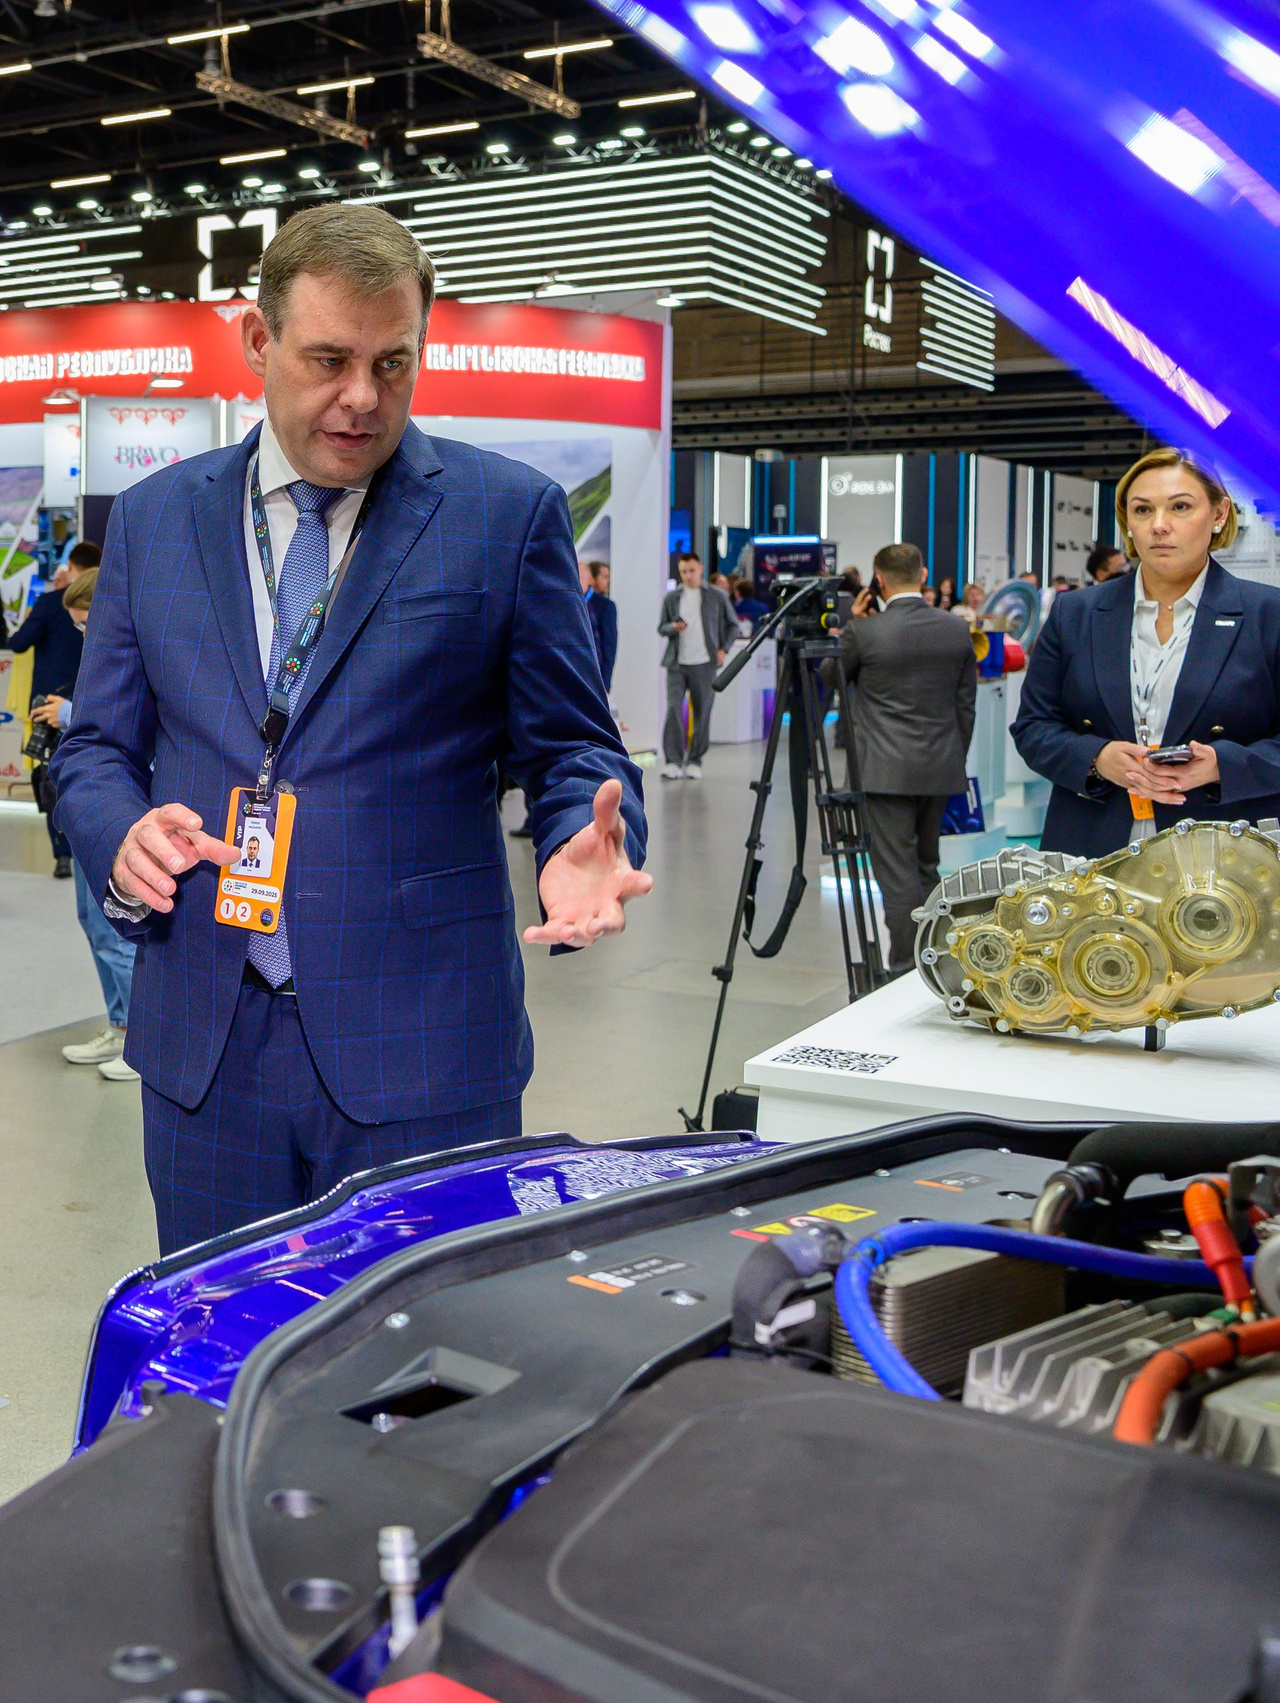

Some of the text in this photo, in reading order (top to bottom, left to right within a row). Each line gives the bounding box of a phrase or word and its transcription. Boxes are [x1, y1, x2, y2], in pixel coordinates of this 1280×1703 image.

[56, 347, 193, 377] РЕСПУБЛИКА
[250, 887, 278, 898] 29.09.2025
[225, 902, 230, 915] 1
[240, 906, 247, 917] 2
